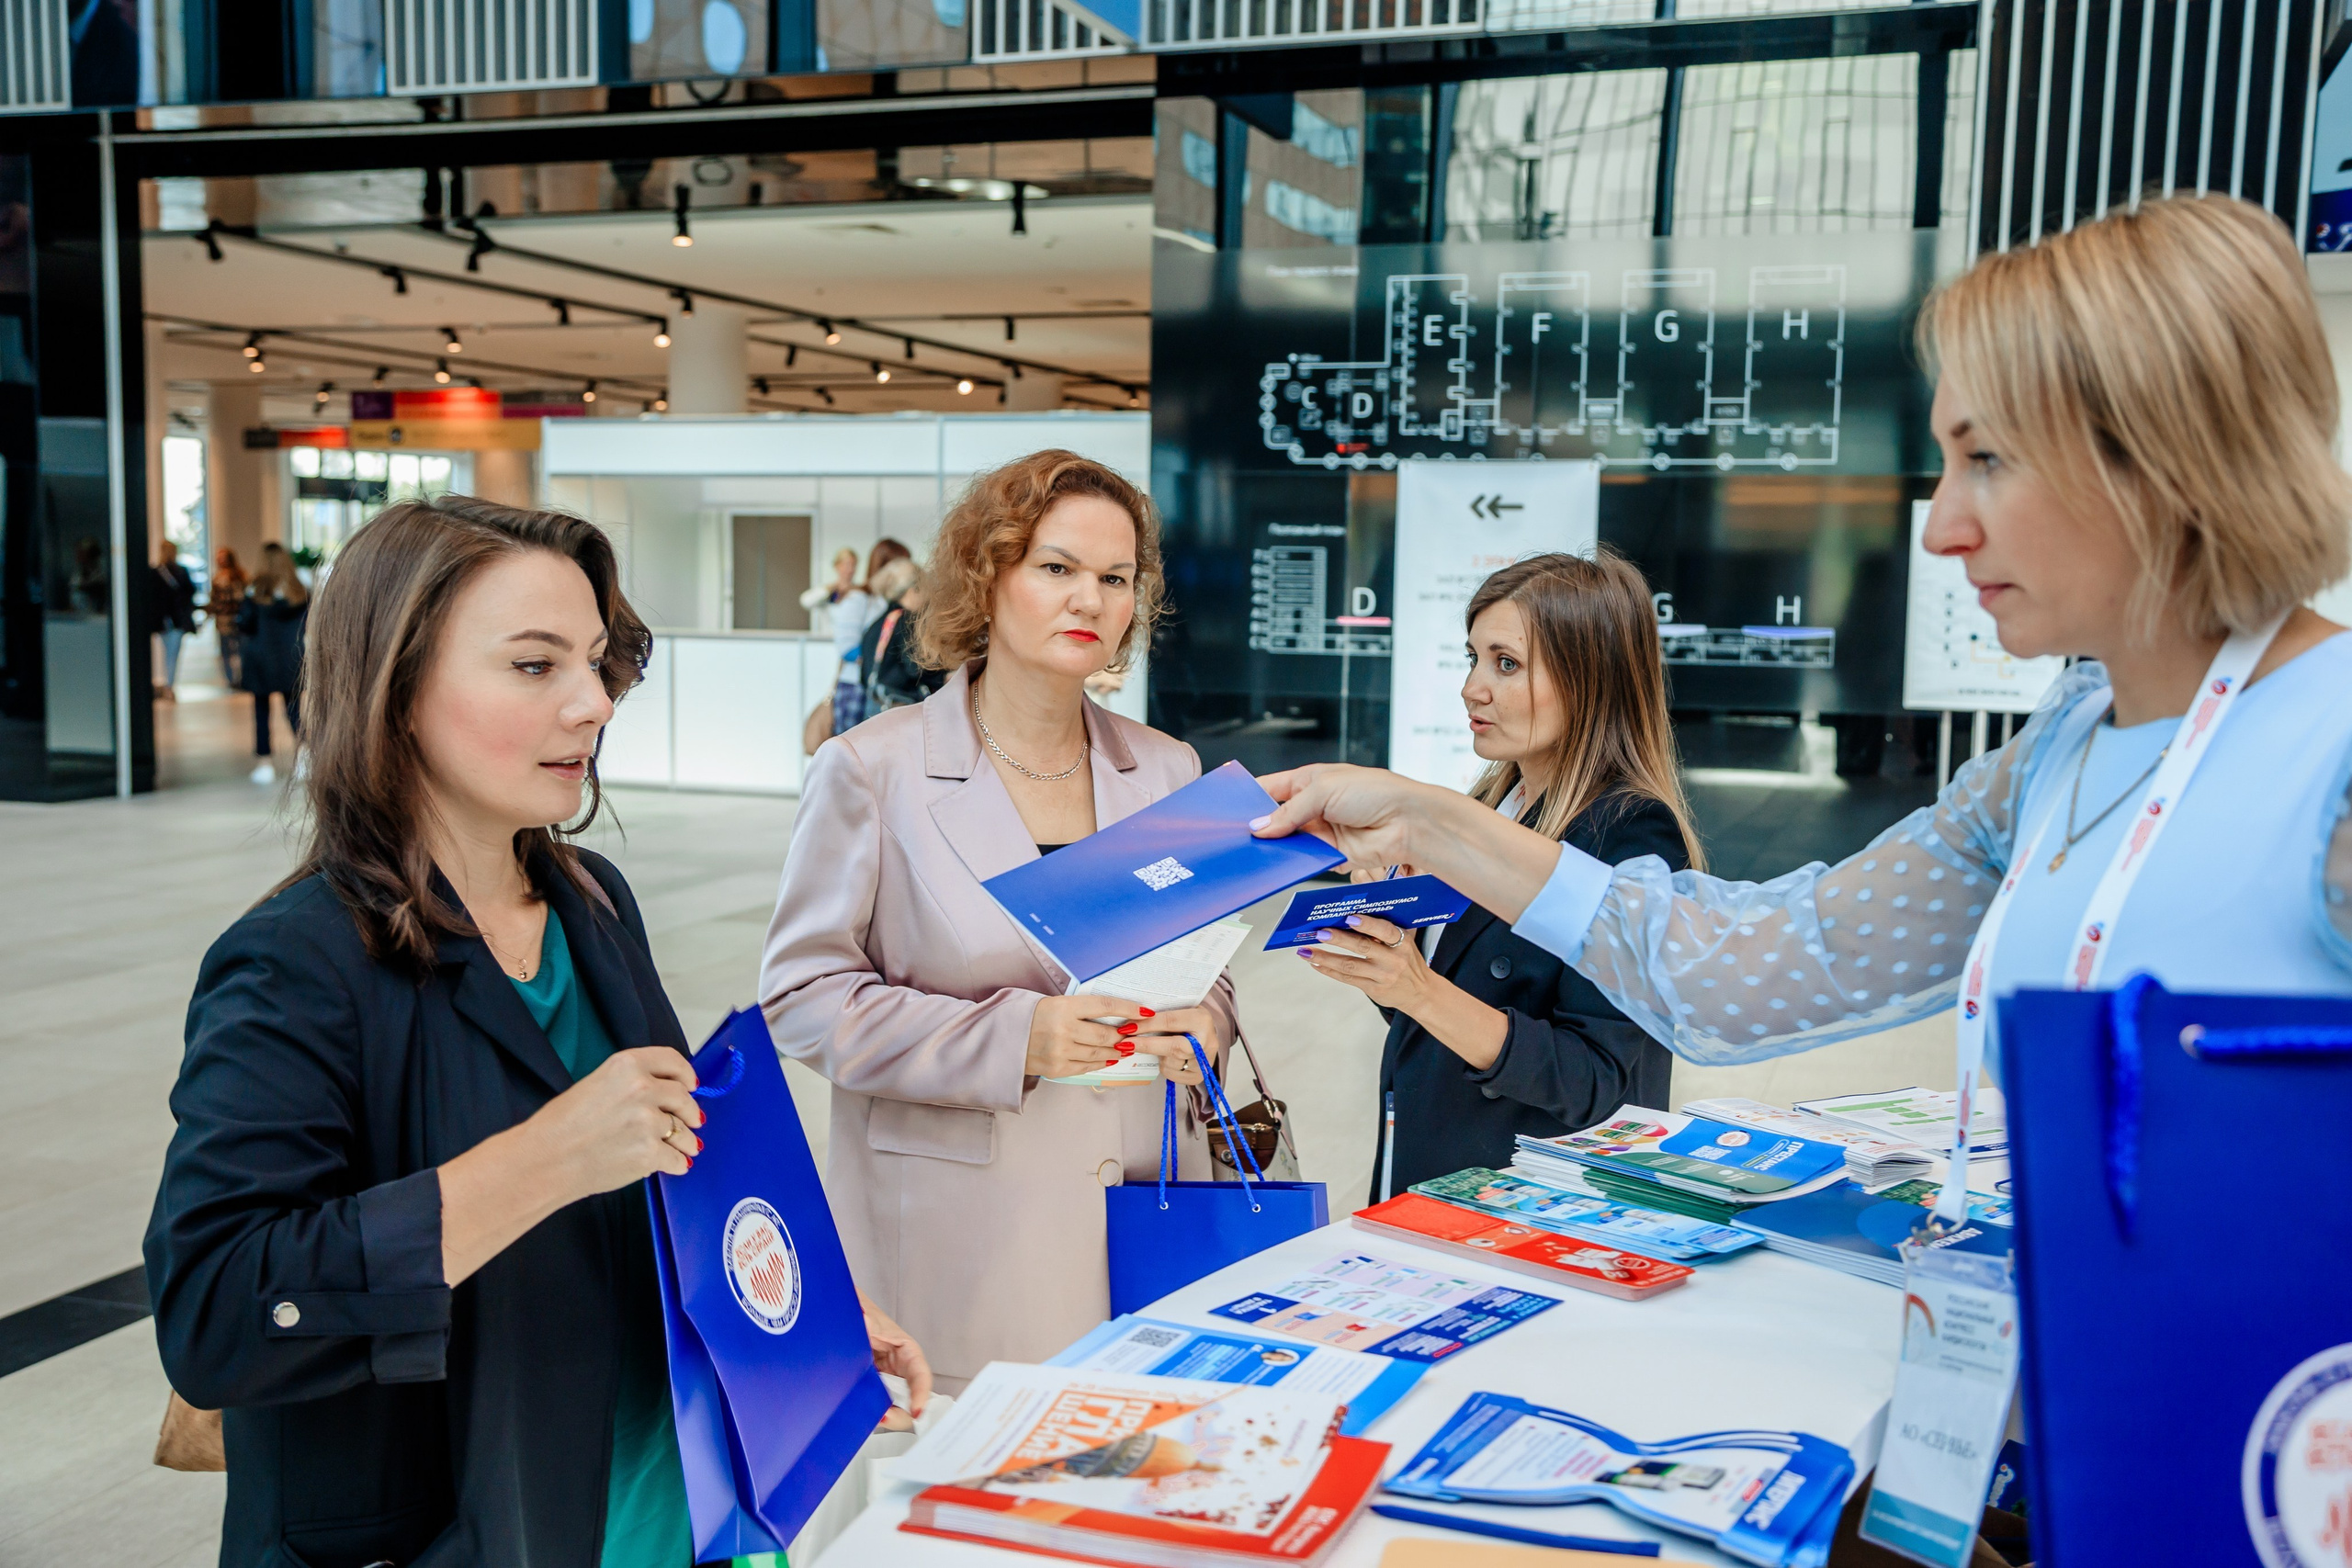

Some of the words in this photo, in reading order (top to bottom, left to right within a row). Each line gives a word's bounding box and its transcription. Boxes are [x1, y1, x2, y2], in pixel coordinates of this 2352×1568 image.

[1423, 314, 1443, 346] E
[1532, 312, 1552, 344] F
[1655, 310, 1679, 343] G
[1782, 309, 1808, 340] H
[1301, 385, 1318, 410] C
[1351, 391, 1374, 419] D
[1351, 586, 1377, 617] D
[1776, 595, 1802, 626] H
[1310, 905, 1351, 916] НАУЧНЫХ
[1351, 896, 1419, 911] СИМПОЗИУМОВ
[1313, 897, 1368, 910] ПРОГРАММА
[1411, 913, 1455, 924] SERVIER
[1753, 1141, 1805, 1171] ПРЕСТАНС
